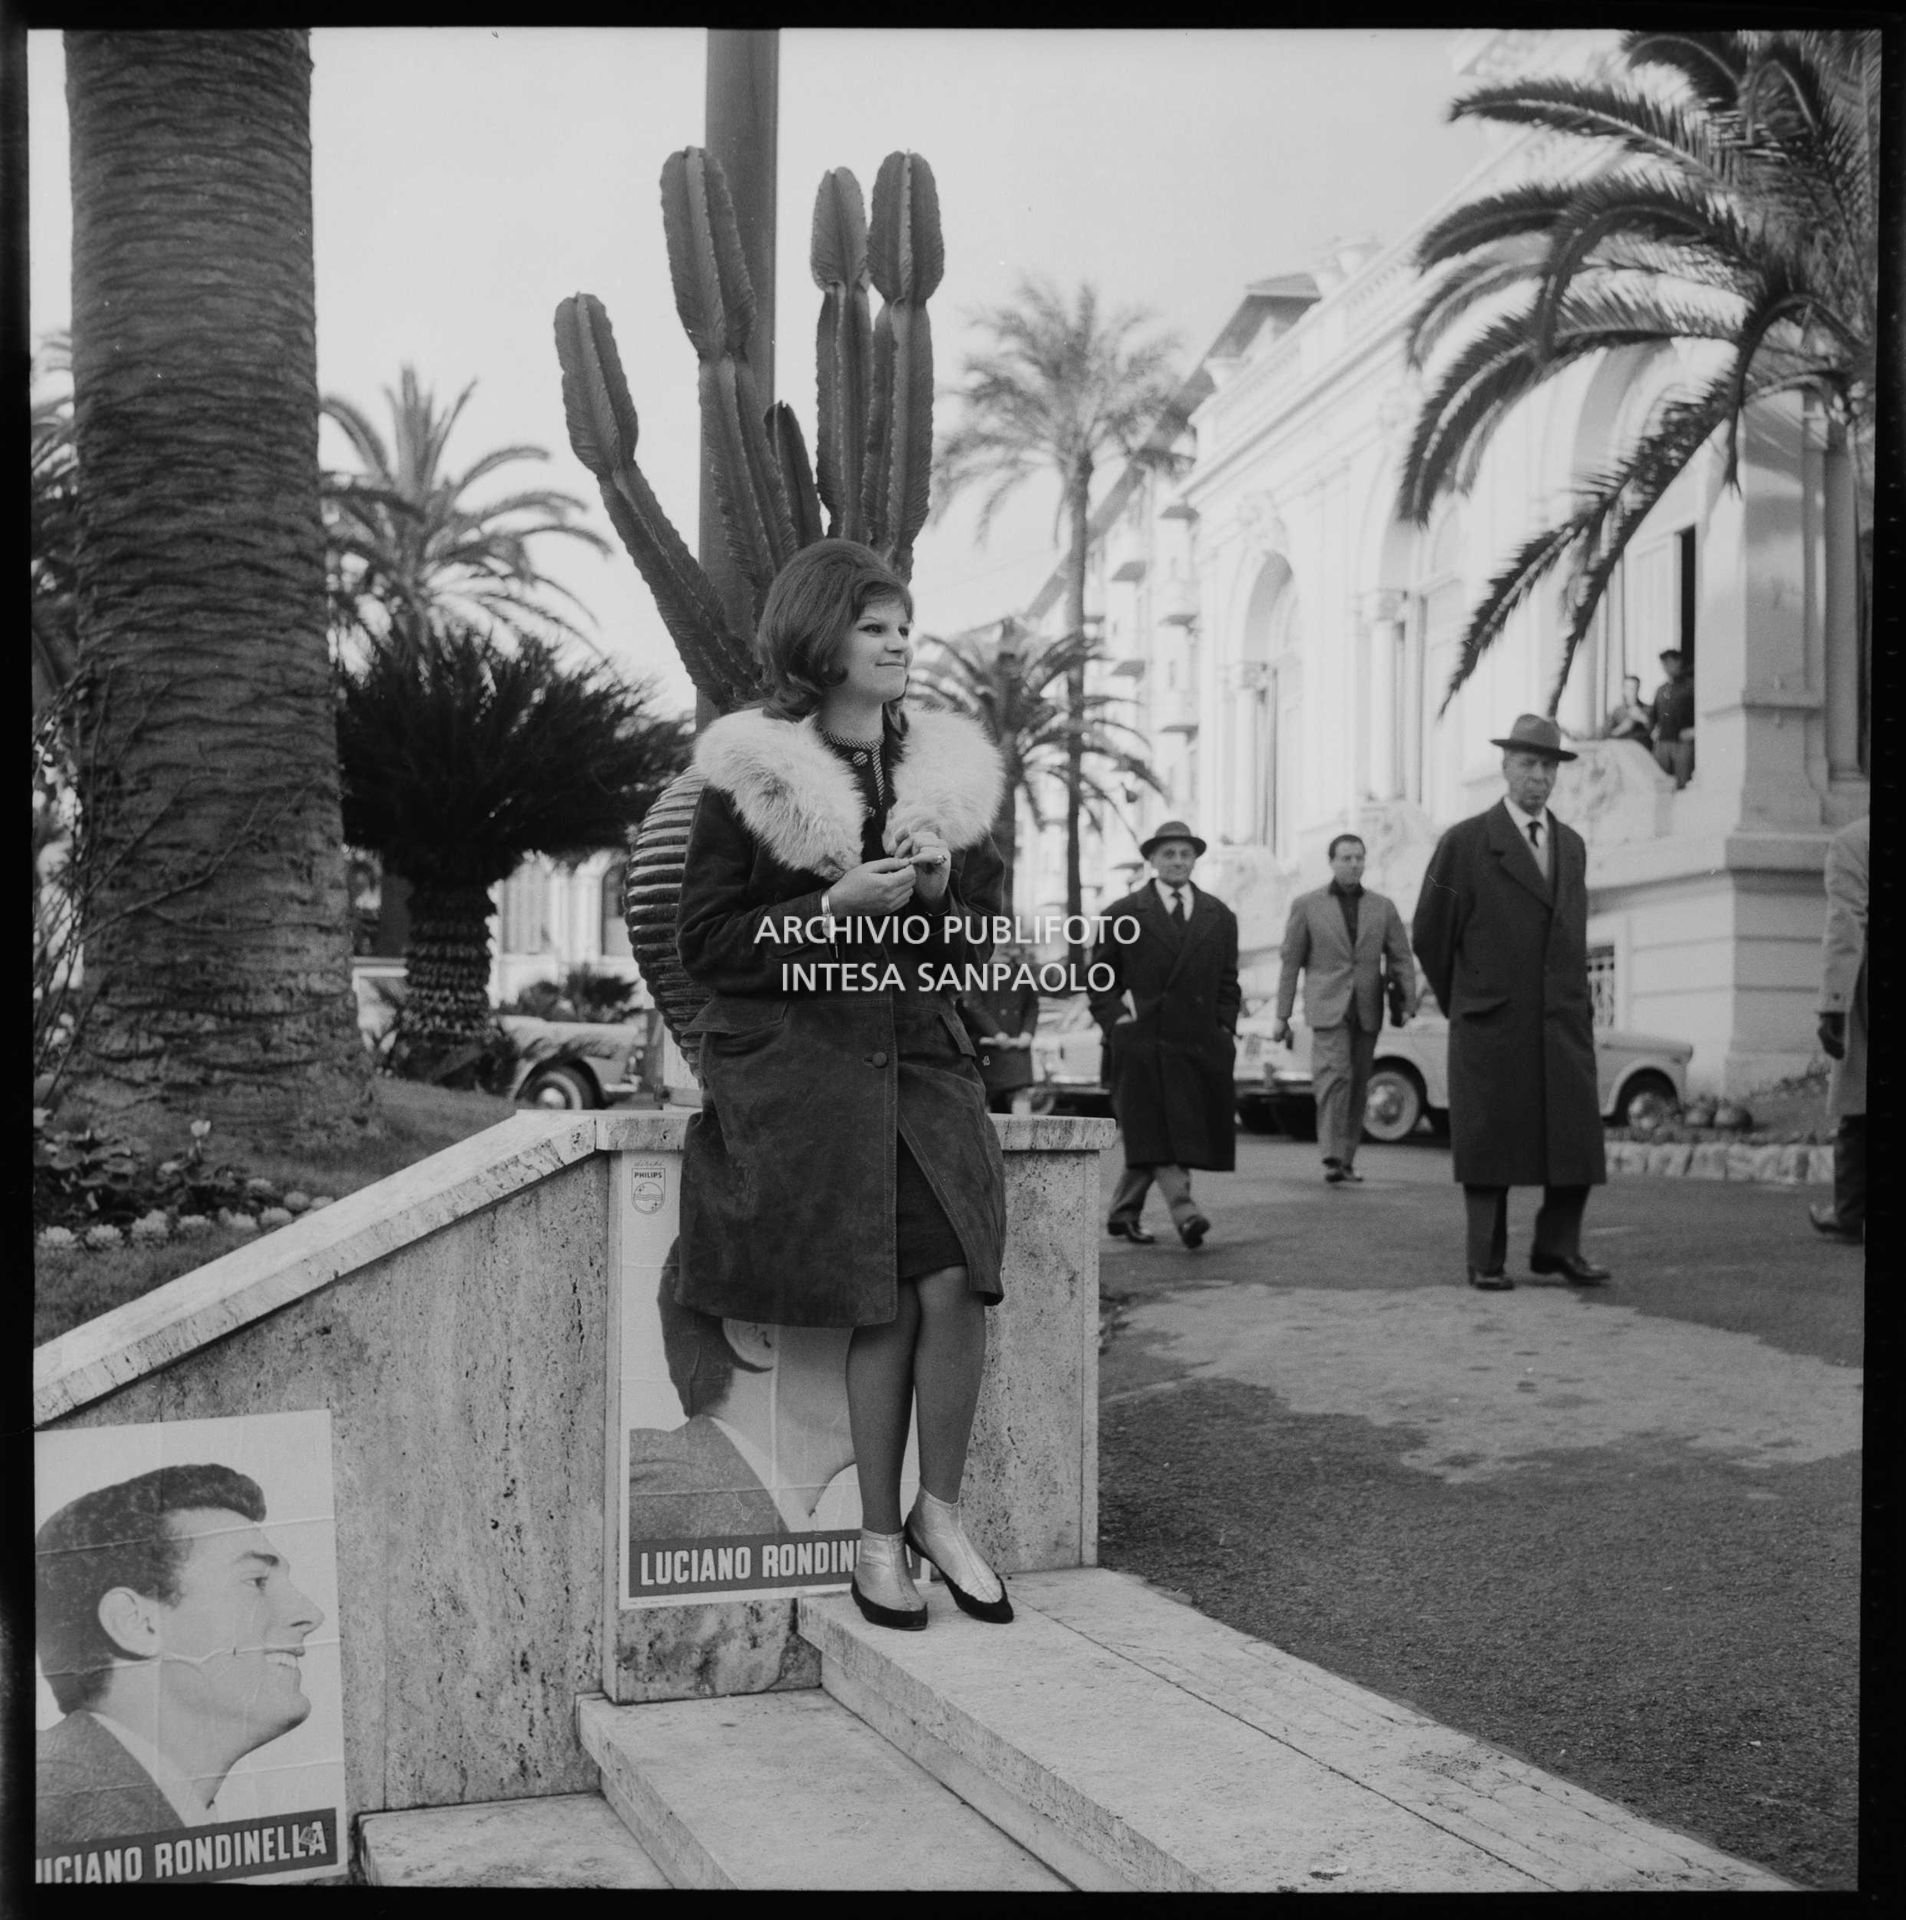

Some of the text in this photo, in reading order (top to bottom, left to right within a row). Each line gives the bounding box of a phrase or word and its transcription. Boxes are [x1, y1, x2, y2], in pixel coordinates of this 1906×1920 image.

[634, 1171, 663, 1179] PHILIPS
[640, 1539, 912, 1586] LUCIANO RONDIN
[36, 1820, 328, 1884] UCIANO RONDINELLA
